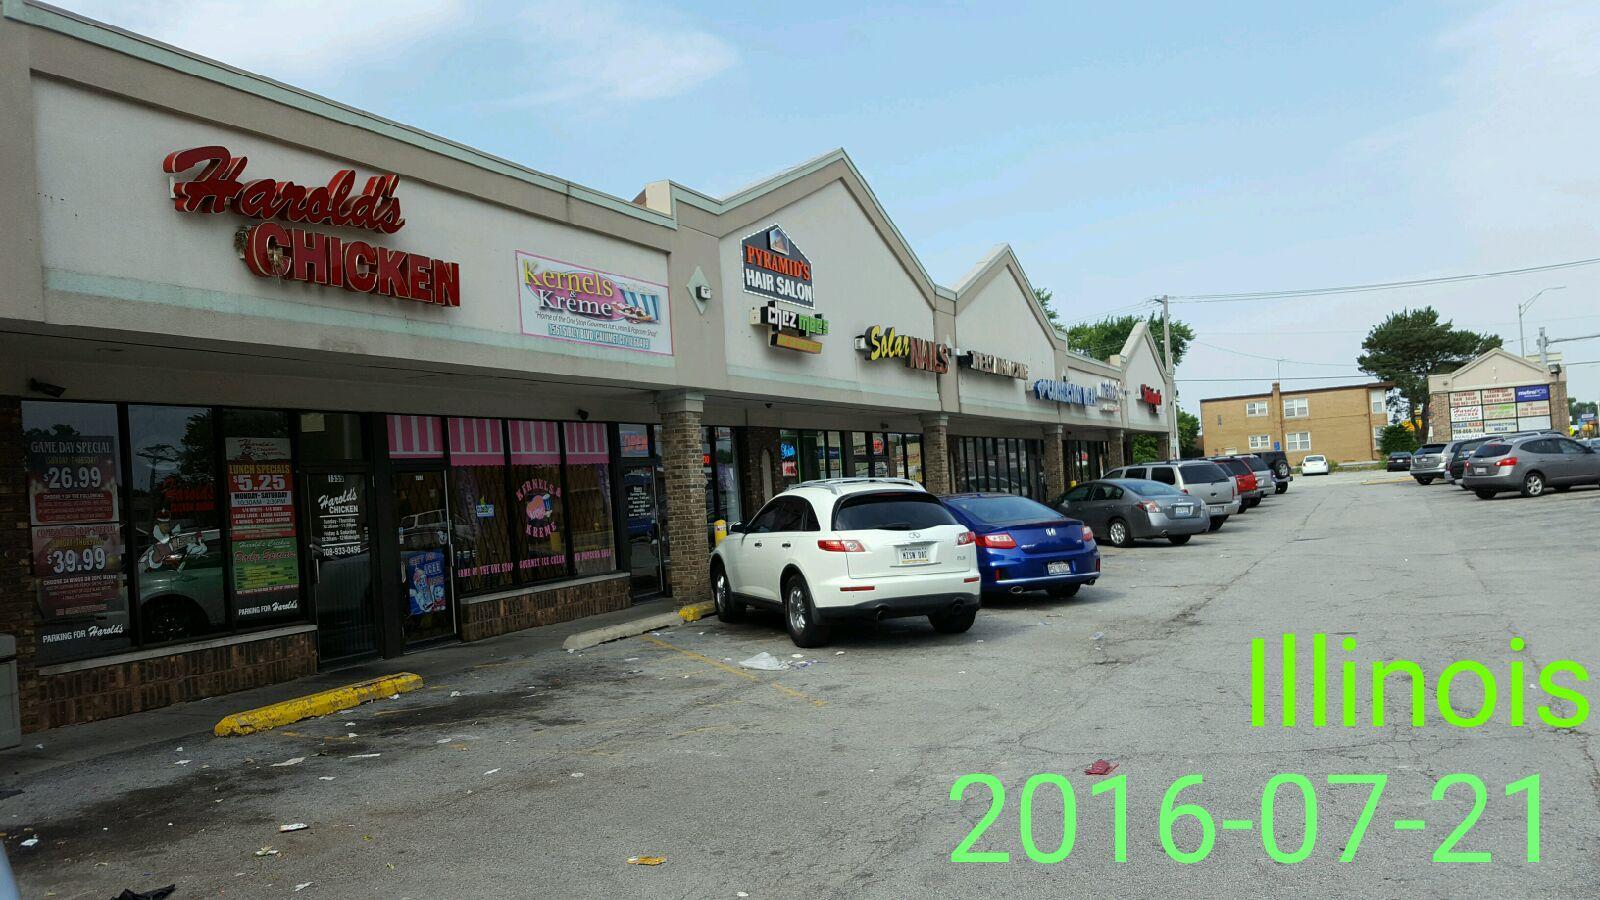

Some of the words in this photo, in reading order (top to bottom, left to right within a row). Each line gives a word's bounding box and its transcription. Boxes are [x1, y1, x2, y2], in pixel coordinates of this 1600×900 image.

[163, 146, 407, 235] Harold's
[246, 221, 460, 308] CHICKEN
[745, 244, 811, 281] PYRAMID'S
[523, 259, 614, 298] Kernels
[745, 268, 775, 292] HAIR
[776, 276, 813, 303] SALON
[868, 325, 911, 361] Solar
[911, 337, 950, 375] NAILS
[31, 441, 58, 454] GAME
[59, 441, 75, 454] DAY
[75, 441, 112, 454] SPECIAL
[42, 466, 102, 489] $26.99
[229, 463, 256, 475] LUNCH
[256, 463, 290, 474] SPECIALS
[233, 474, 286, 491] $5.25
[318, 487, 358, 510] Harold's
[328, 505, 359, 514] CHICKEN
[526, 521, 557, 538] KREME
[47, 547, 106, 573] $39.99
[501, 562, 513, 573] STOP
[238, 606, 261, 616] PARKING
[260, 604, 271, 613] FOR
[271, 599, 298, 612] Harold's
[42, 632, 72, 644] PARKING
[73, 630, 86, 639] FOR
[87, 624, 124, 638] Harold's
